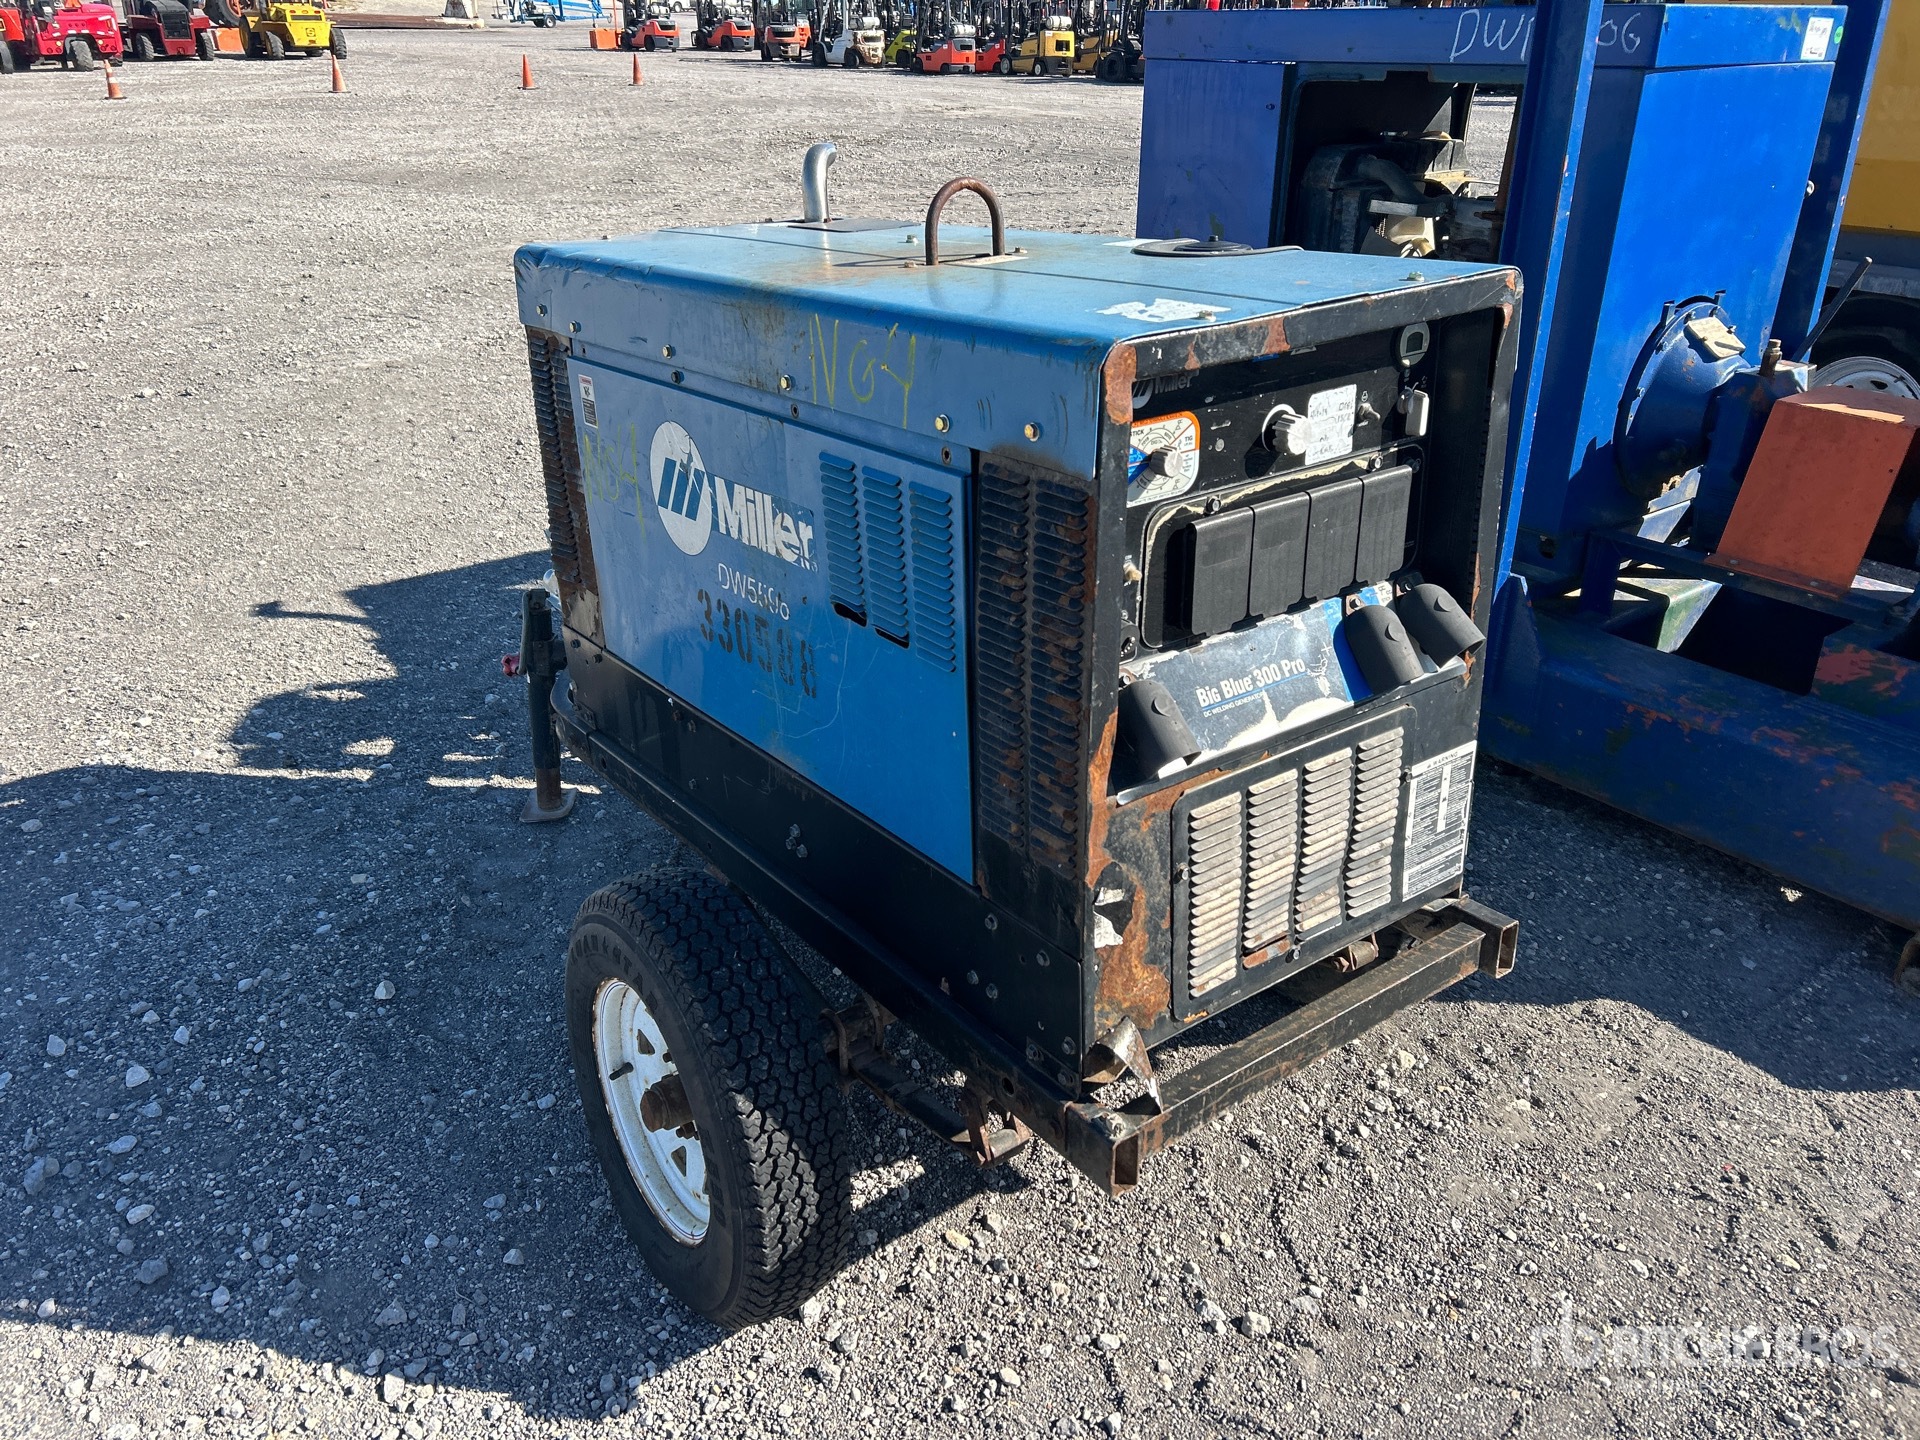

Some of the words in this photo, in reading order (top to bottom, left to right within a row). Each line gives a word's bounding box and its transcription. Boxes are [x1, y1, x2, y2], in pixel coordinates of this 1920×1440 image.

[1154, 375, 1192, 394] Miller
[1131, 429, 1145, 437] TICK
[714, 475, 813, 571] Miller
[1220, 675, 1254, 700] Blue
[1255, 663, 1283, 688] 300
[1282, 657, 1307, 681] Pro
[1202, 710, 1213, 718] DC
[1211, 702, 1236, 715] WELDING
